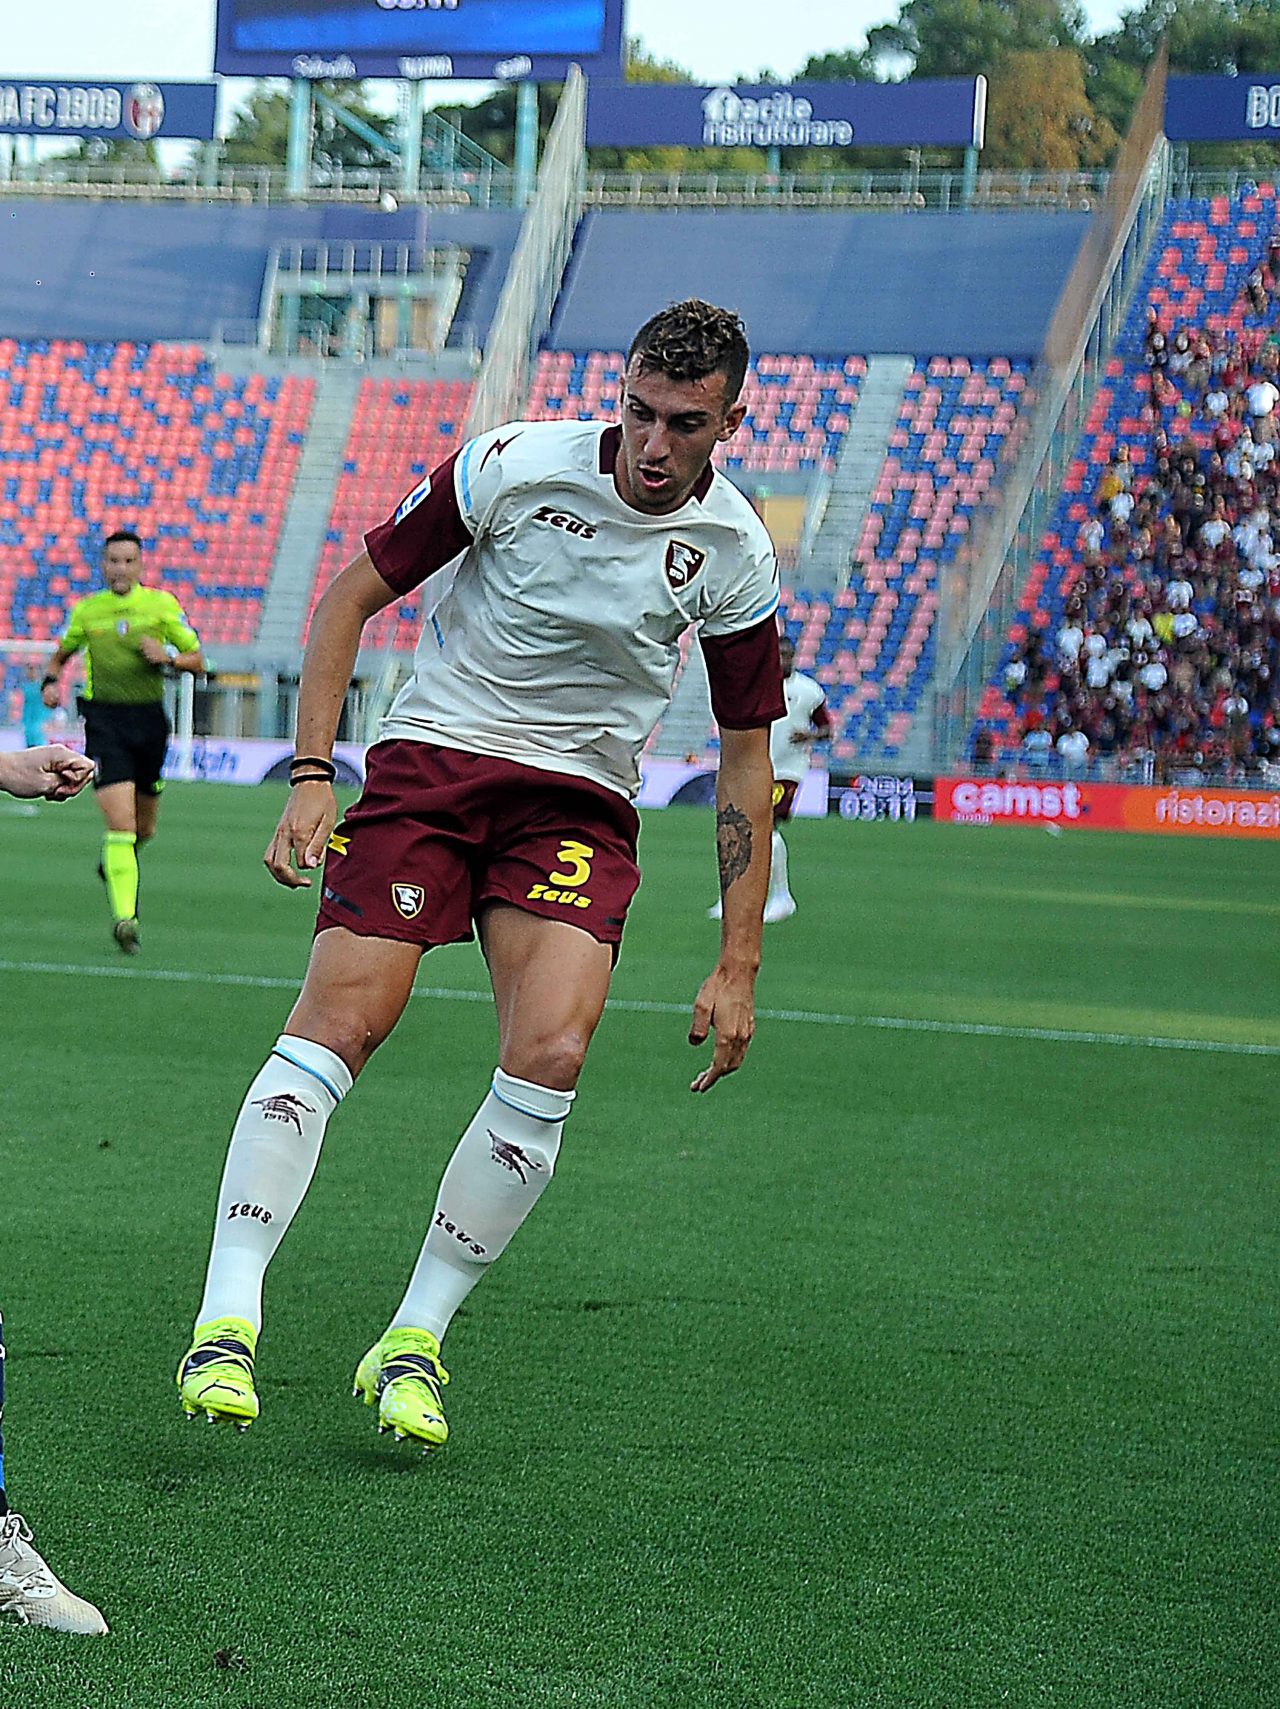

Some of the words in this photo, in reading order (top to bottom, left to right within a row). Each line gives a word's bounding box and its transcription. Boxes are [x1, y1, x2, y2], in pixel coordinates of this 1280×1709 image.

[21, 86, 55, 127] FC
[56, 87, 121, 128] 1909
[531, 505, 598, 540] Zeus
[549, 840, 594, 887] 3
[526, 883, 592, 908] Zeus
